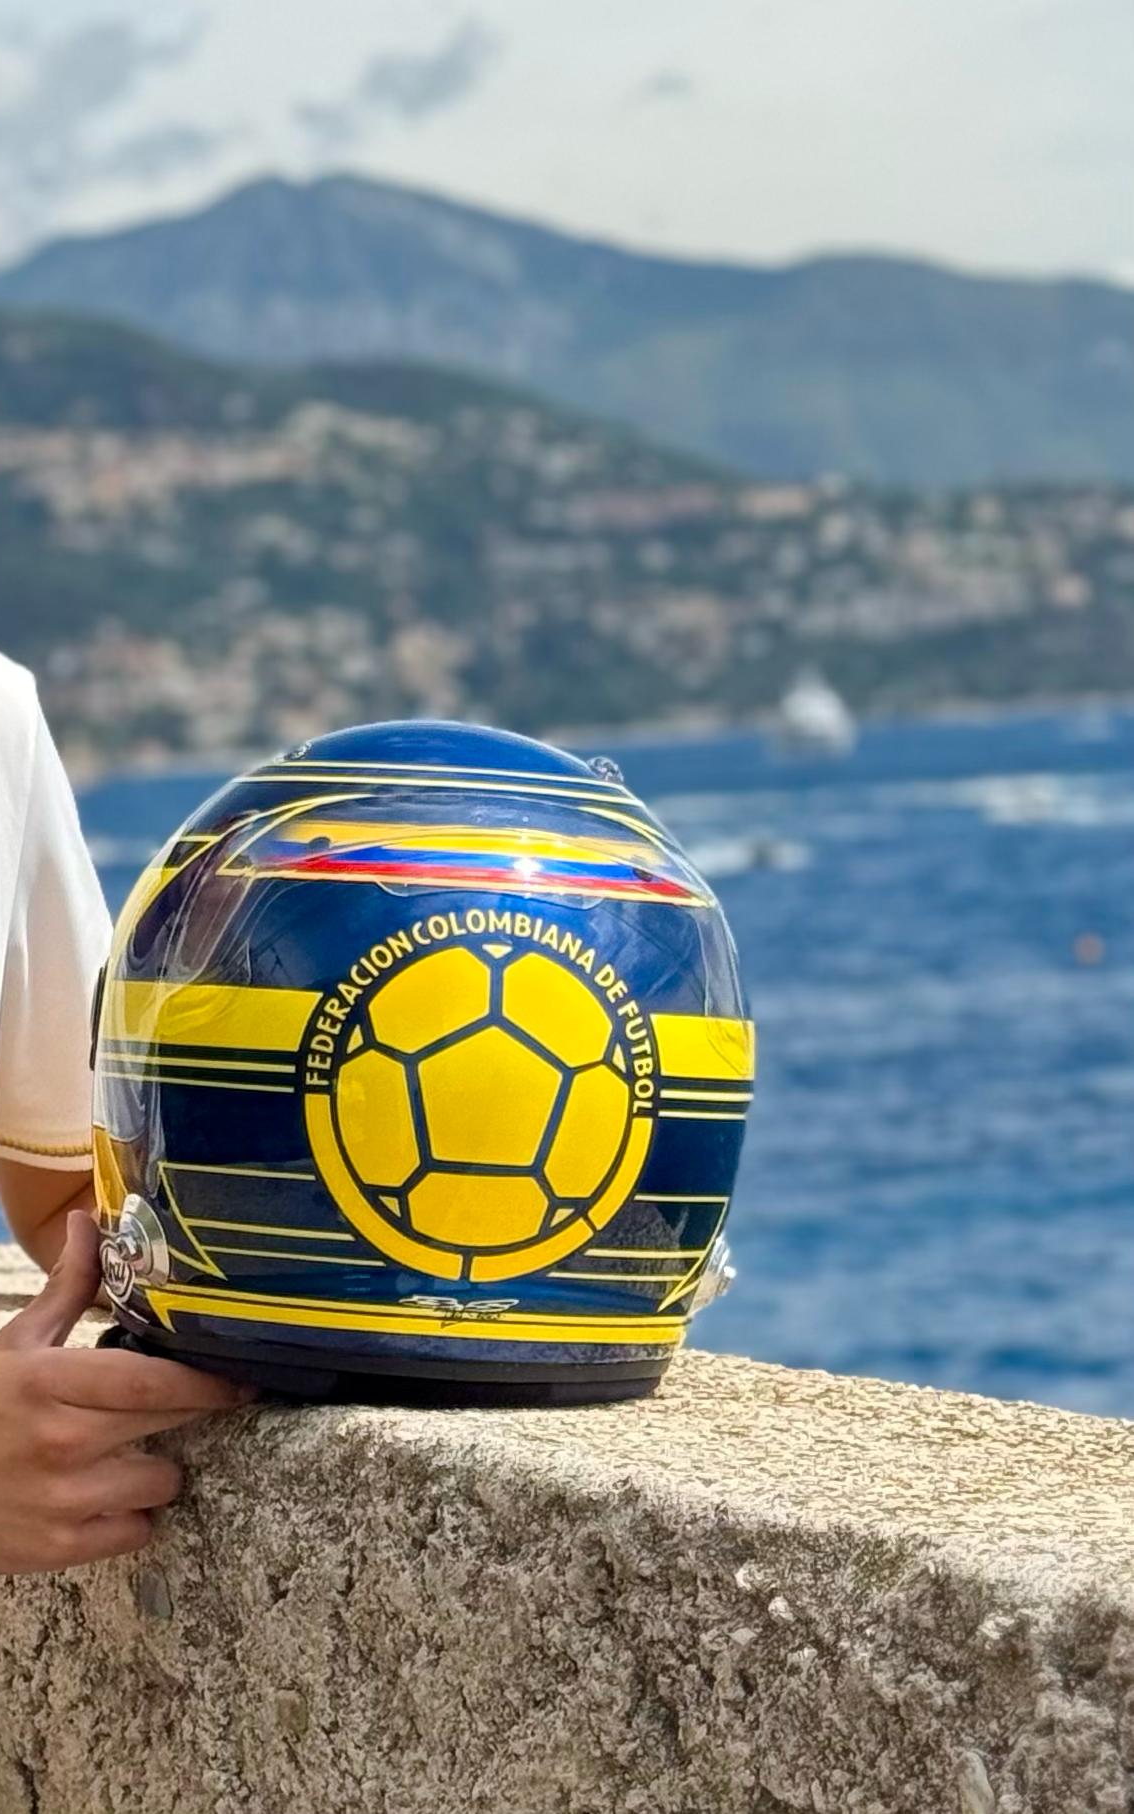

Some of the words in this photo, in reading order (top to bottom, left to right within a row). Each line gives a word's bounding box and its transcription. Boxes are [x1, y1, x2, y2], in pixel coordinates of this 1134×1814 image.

[304, 929, 414, 1087] FEDERACION
[411, 908, 594, 975] COLOMBIANA
[593, 963, 629, 1004] DE
[616, 999, 656, 1114] FUTBOL
